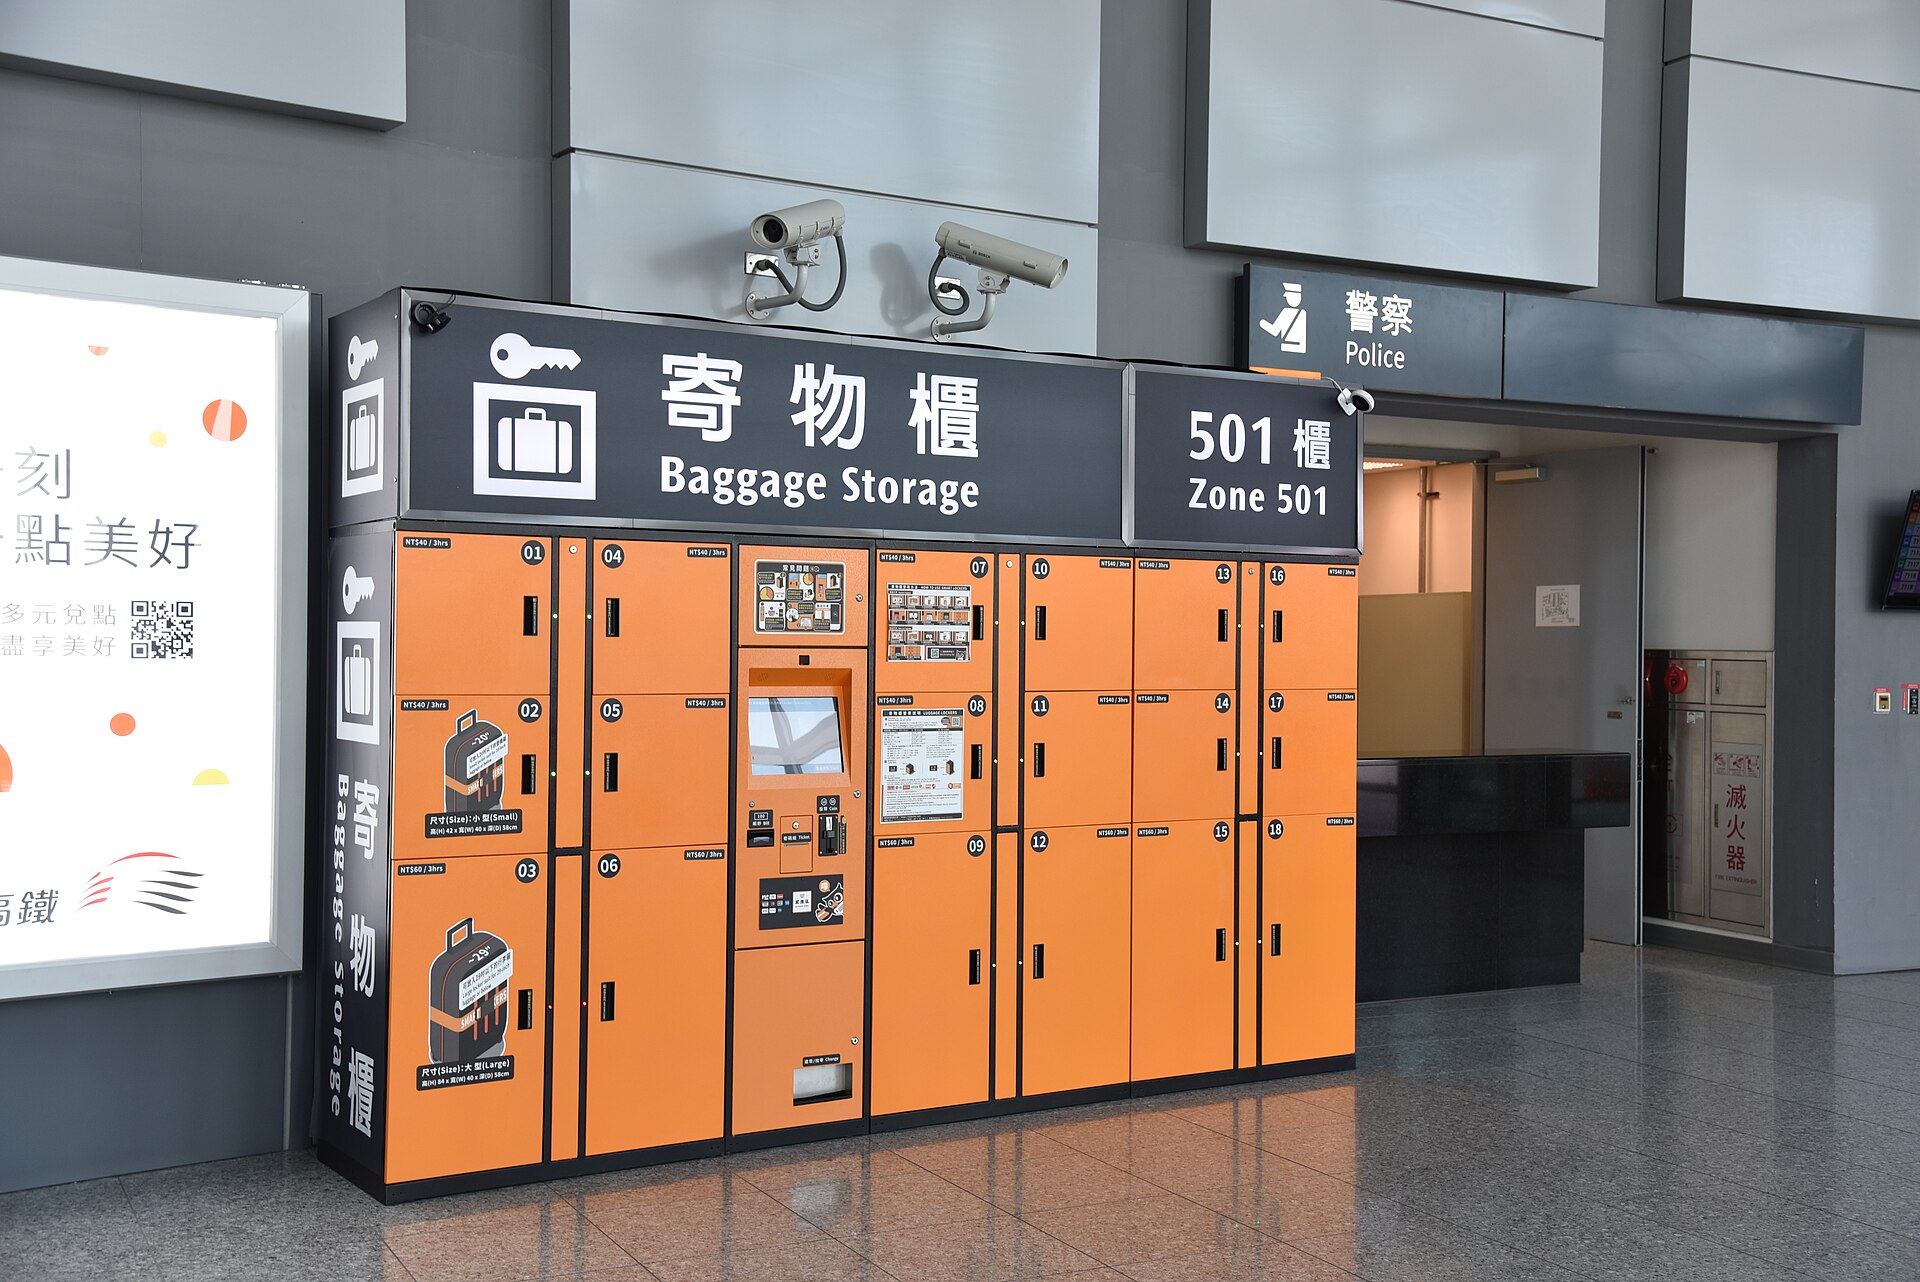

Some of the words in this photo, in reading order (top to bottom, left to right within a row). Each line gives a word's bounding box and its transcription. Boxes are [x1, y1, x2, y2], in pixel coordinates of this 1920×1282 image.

[1346, 290, 1412, 336] 警察
[1346, 340, 1405, 369] Police
[662, 352, 979, 458] 寄物櫃
[1189, 410, 1270, 464] 501
[1292, 418, 1331, 470] 櫃
[0, 446, 70, 499] 刻
[662, 456, 826, 508] Baggage
[842, 466, 979, 515] Storage
[1188, 478, 1264, 512] Zone
[1278, 484, 1326, 516] 501
[0, 514, 202, 570] 點美好
[524, 546, 542, 560] 01
[605, 550, 622, 563] 04
[972, 561, 986, 573] 07
[1034, 563, 1048, 574] 10
[1218, 568, 1229, 579] 13
[1272, 570, 1283, 581] 16
[970, 700, 983, 712] 08
[1034, 700, 1047, 712] 11
[1217, 698, 1229, 708] 14
[1271, 697, 1282, 708] 17
[521, 704, 538, 717] 02
[603, 704, 620, 717] 05
[1216, 826, 1227, 837] 15
[1270, 824, 1281, 835] 18
[1726, 784, 1746, 871] 滅火器
[970, 840, 983, 852] 09
[1033, 836, 1046, 847] 12
[333, 774, 350, 942] Baggage
[519, 864, 536, 877] 03
[601, 859, 618, 873] 06
[348, 779, 380, 1138] 寄物櫃
[330, 960, 344, 1116] Storage
